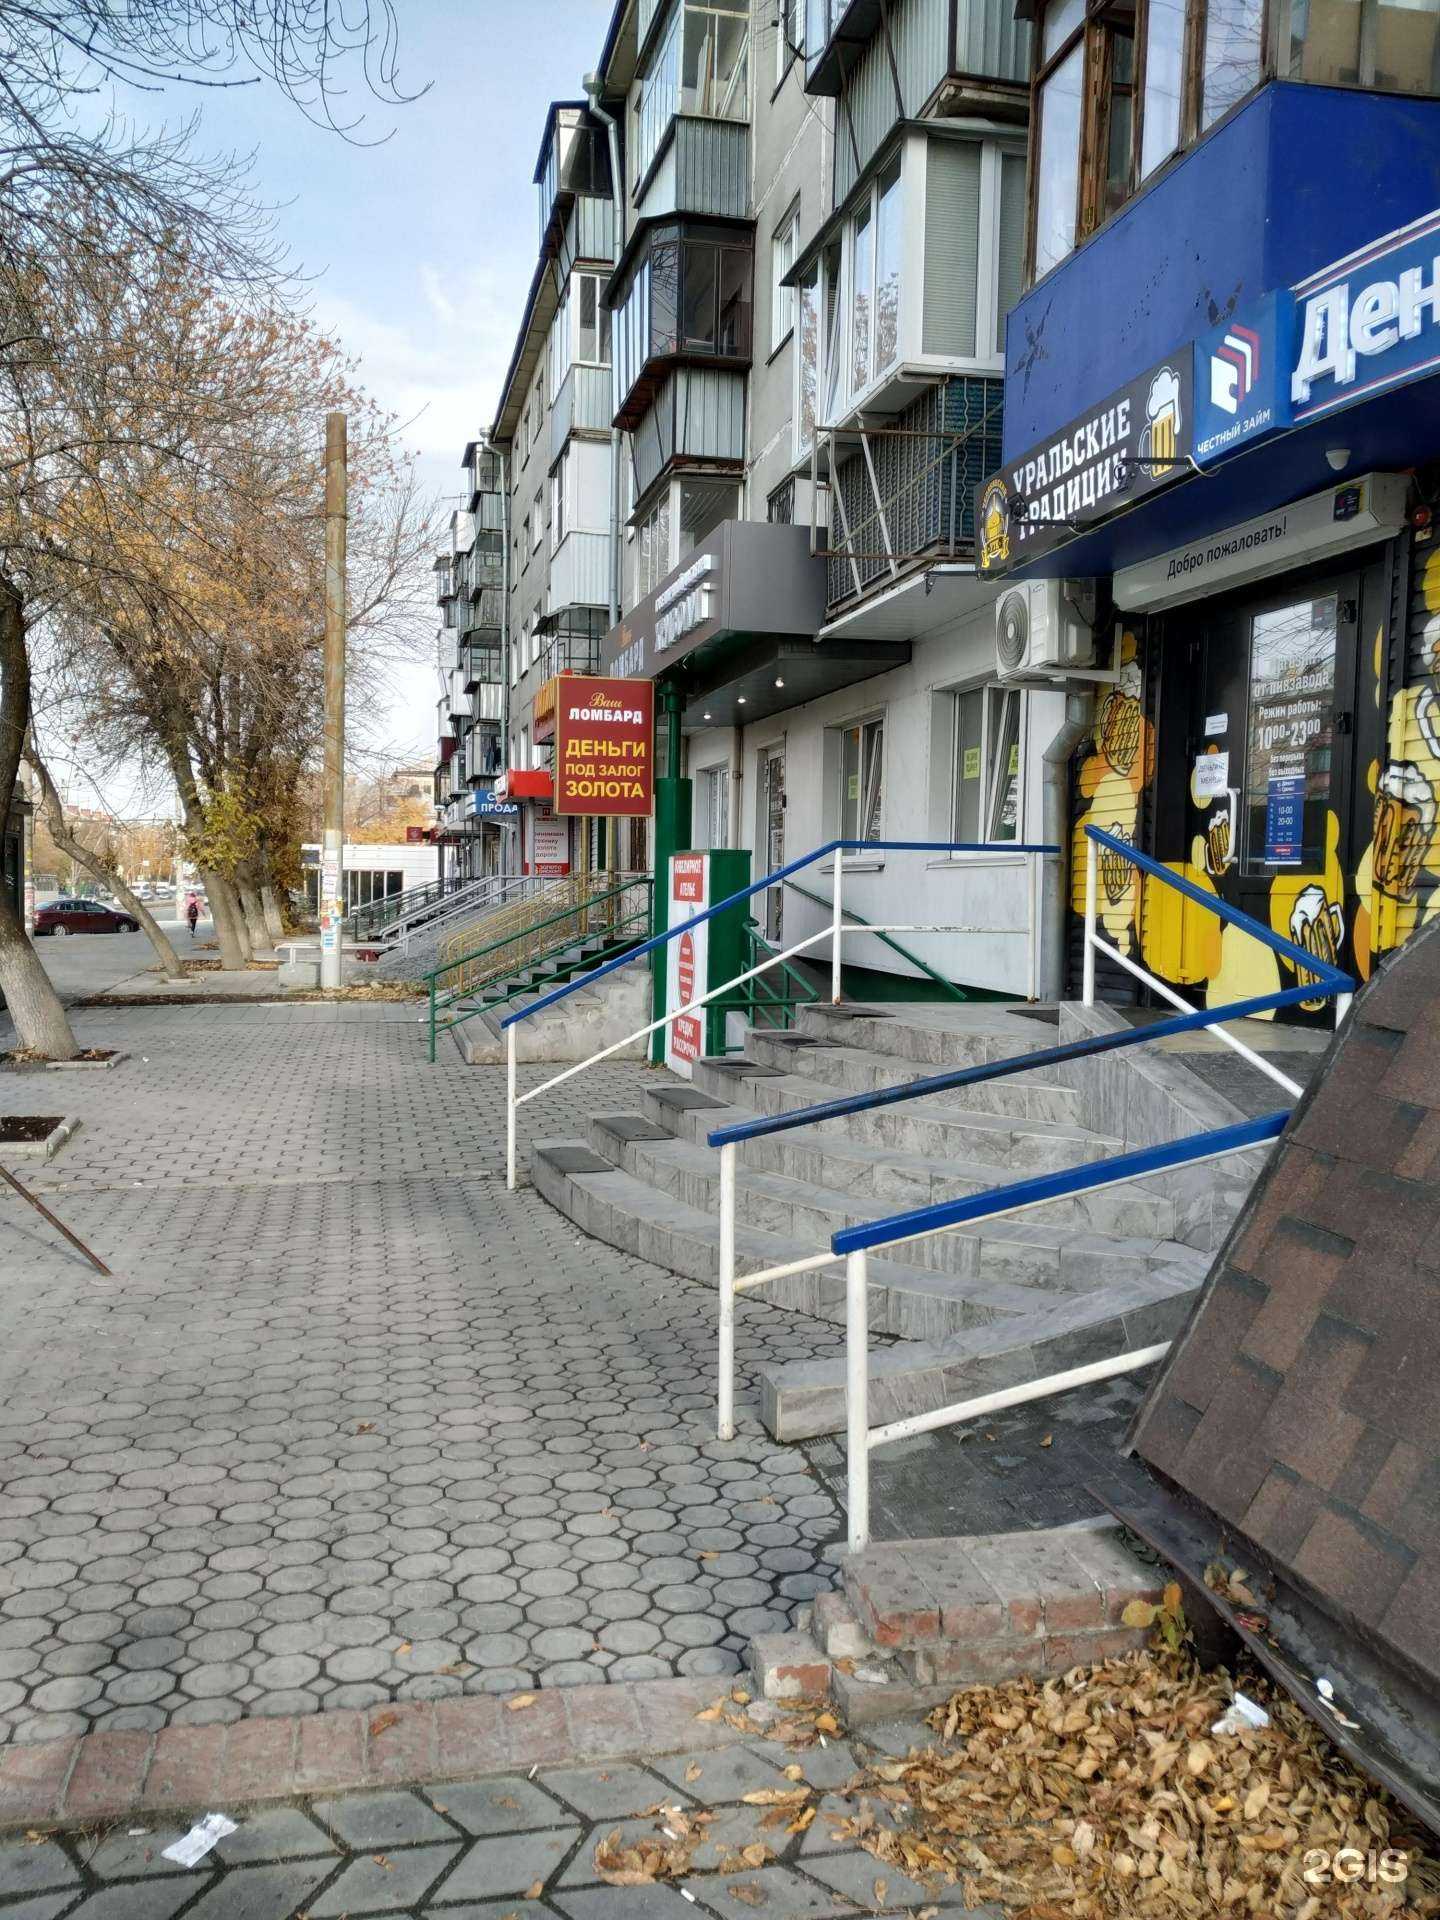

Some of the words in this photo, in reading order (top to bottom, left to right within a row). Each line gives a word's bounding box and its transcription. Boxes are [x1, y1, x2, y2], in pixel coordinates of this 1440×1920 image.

[1197, 421, 1241, 454] ЧЕСТНЫЙ
[1243, 408, 1271, 432] ЗАЙМ
[1012, 398, 1131, 496] УРАЛЬСКИЕ
[1167, 549, 1204, 580] Добро
[1206, 515, 1287, 563] пожаловать!
[1269, 670, 1329, 694] пивзавода
[589, 692, 623, 708] Ваш
[569, 708, 643, 724] ЛОМБАРД
[1259, 706, 1286, 721] Режим
[566, 739, 646, 759] ДЕНЬГИ
[565, 763, 596, 777] ПОД
[599, 764, 645, 777] ЗАЛОГ
[566, 781, 645, 798] ЗОЛОТА
